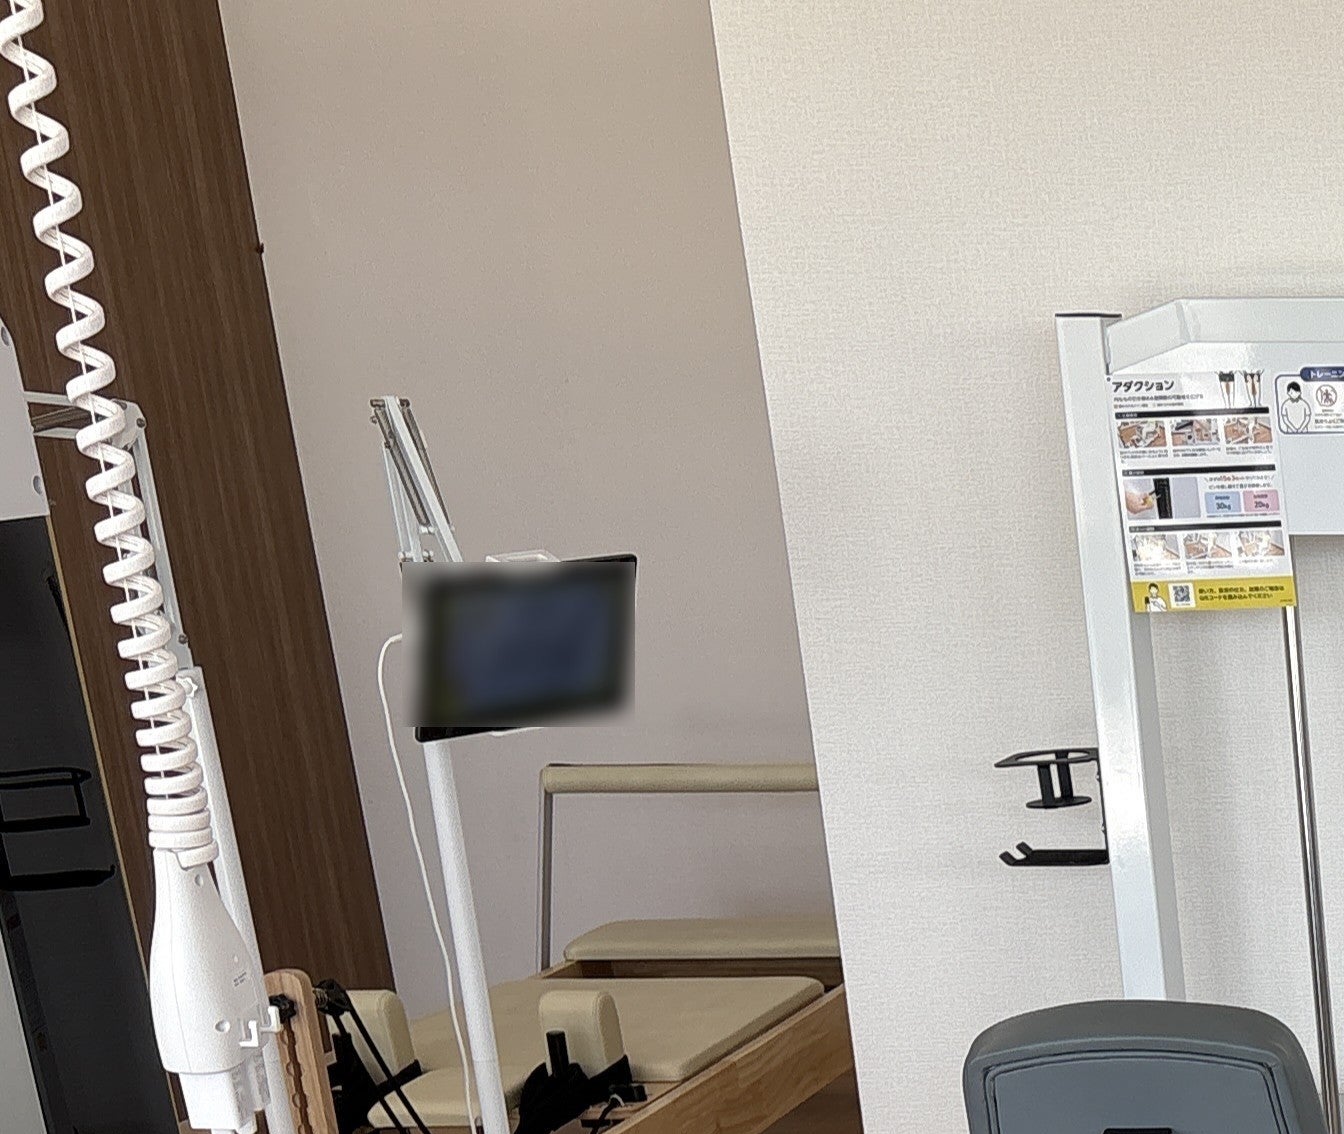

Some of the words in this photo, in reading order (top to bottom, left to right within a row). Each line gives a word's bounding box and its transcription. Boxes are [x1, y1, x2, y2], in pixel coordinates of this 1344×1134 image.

[1112, 380, 1175, 393] アダクション
